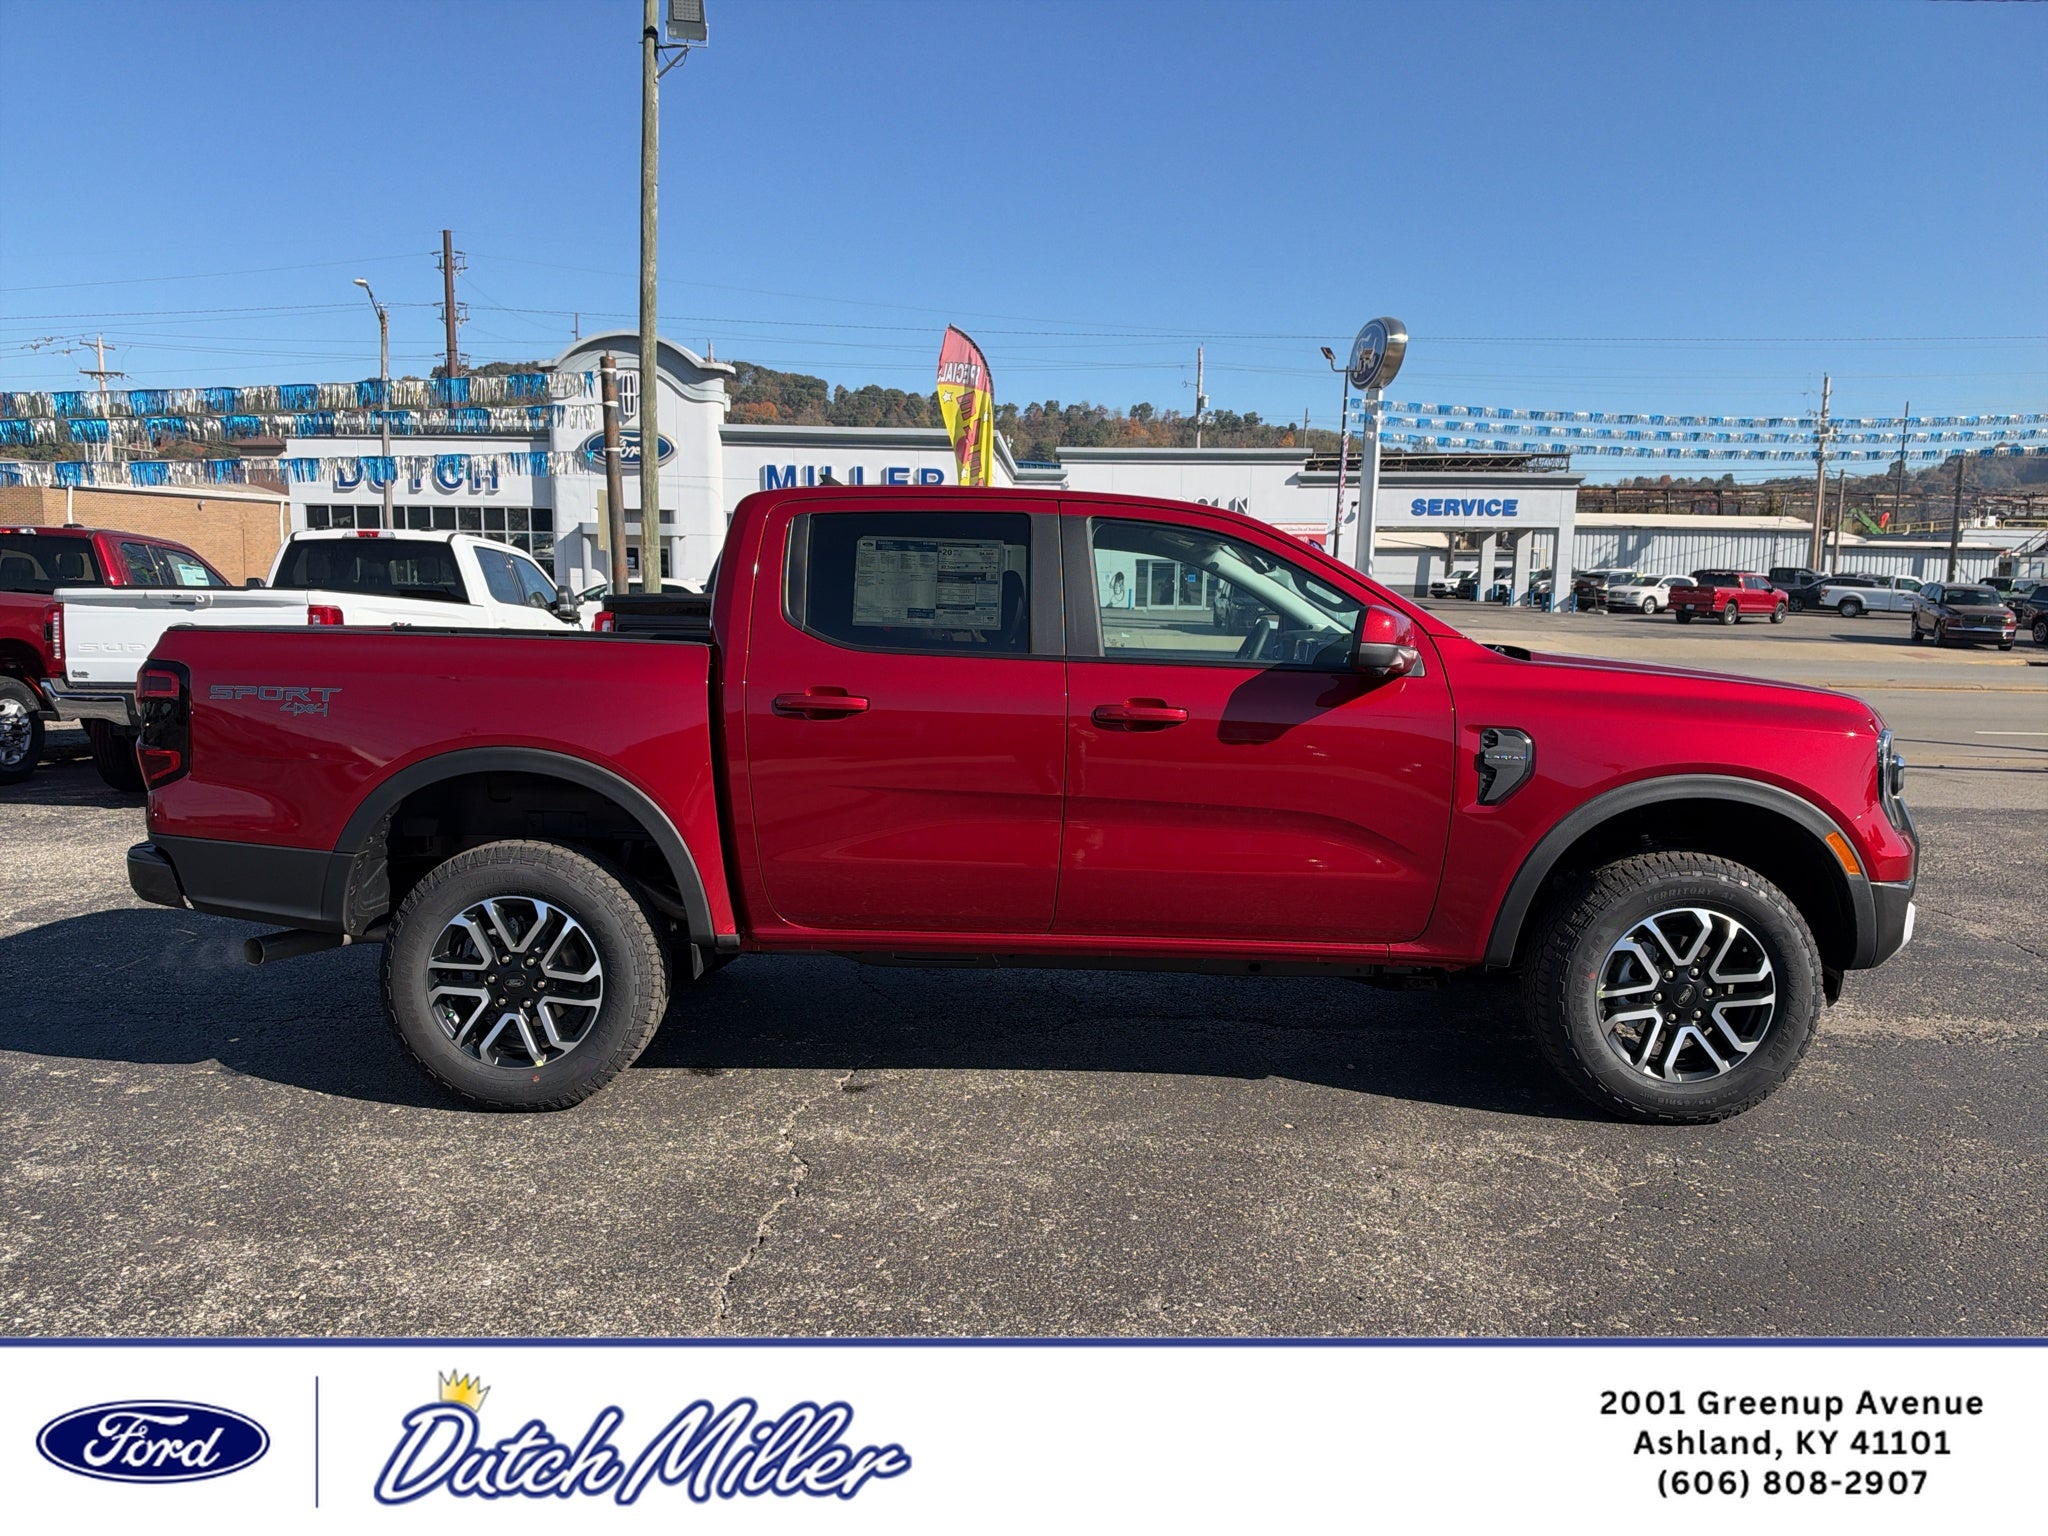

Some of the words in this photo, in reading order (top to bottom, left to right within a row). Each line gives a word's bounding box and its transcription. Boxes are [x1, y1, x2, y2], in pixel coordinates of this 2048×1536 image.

[1411, 498, 1518, 516] SERVICE
[79, 642, 147, 653] SUP
[209, 684, 343, 702] SPORT
[1647, 887, 1714, 904] TERRITORY
